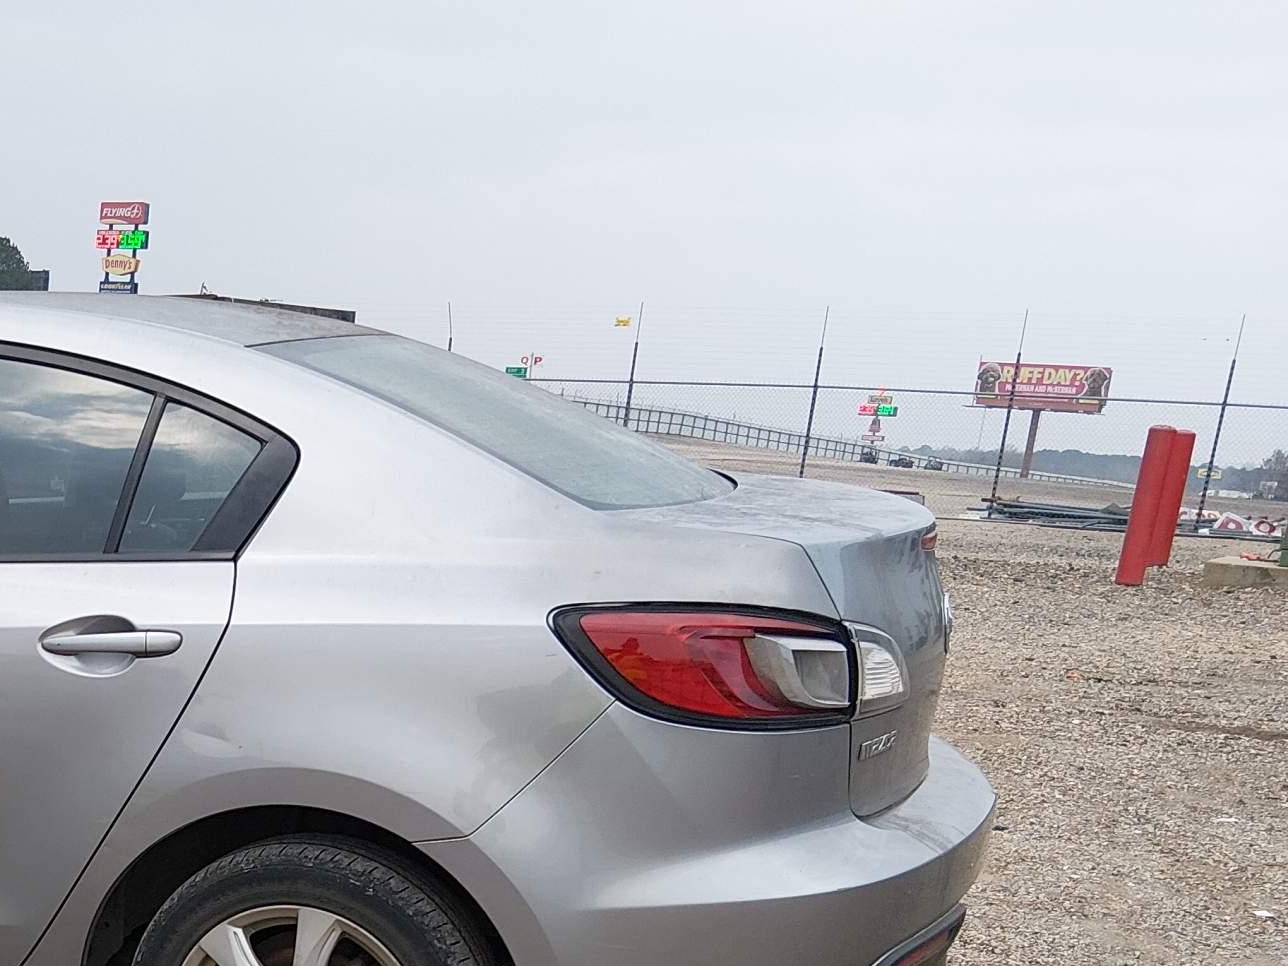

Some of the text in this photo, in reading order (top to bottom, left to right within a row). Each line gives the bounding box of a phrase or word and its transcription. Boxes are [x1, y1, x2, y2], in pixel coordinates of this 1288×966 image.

[102, 207, 131, 217] FLYING
[104, 258, 134, 271] Denny's
[520, 356, 530, 366] Q
[533, 356, 543, 366] P
[1043, 369, 1085, 386] DAY?
